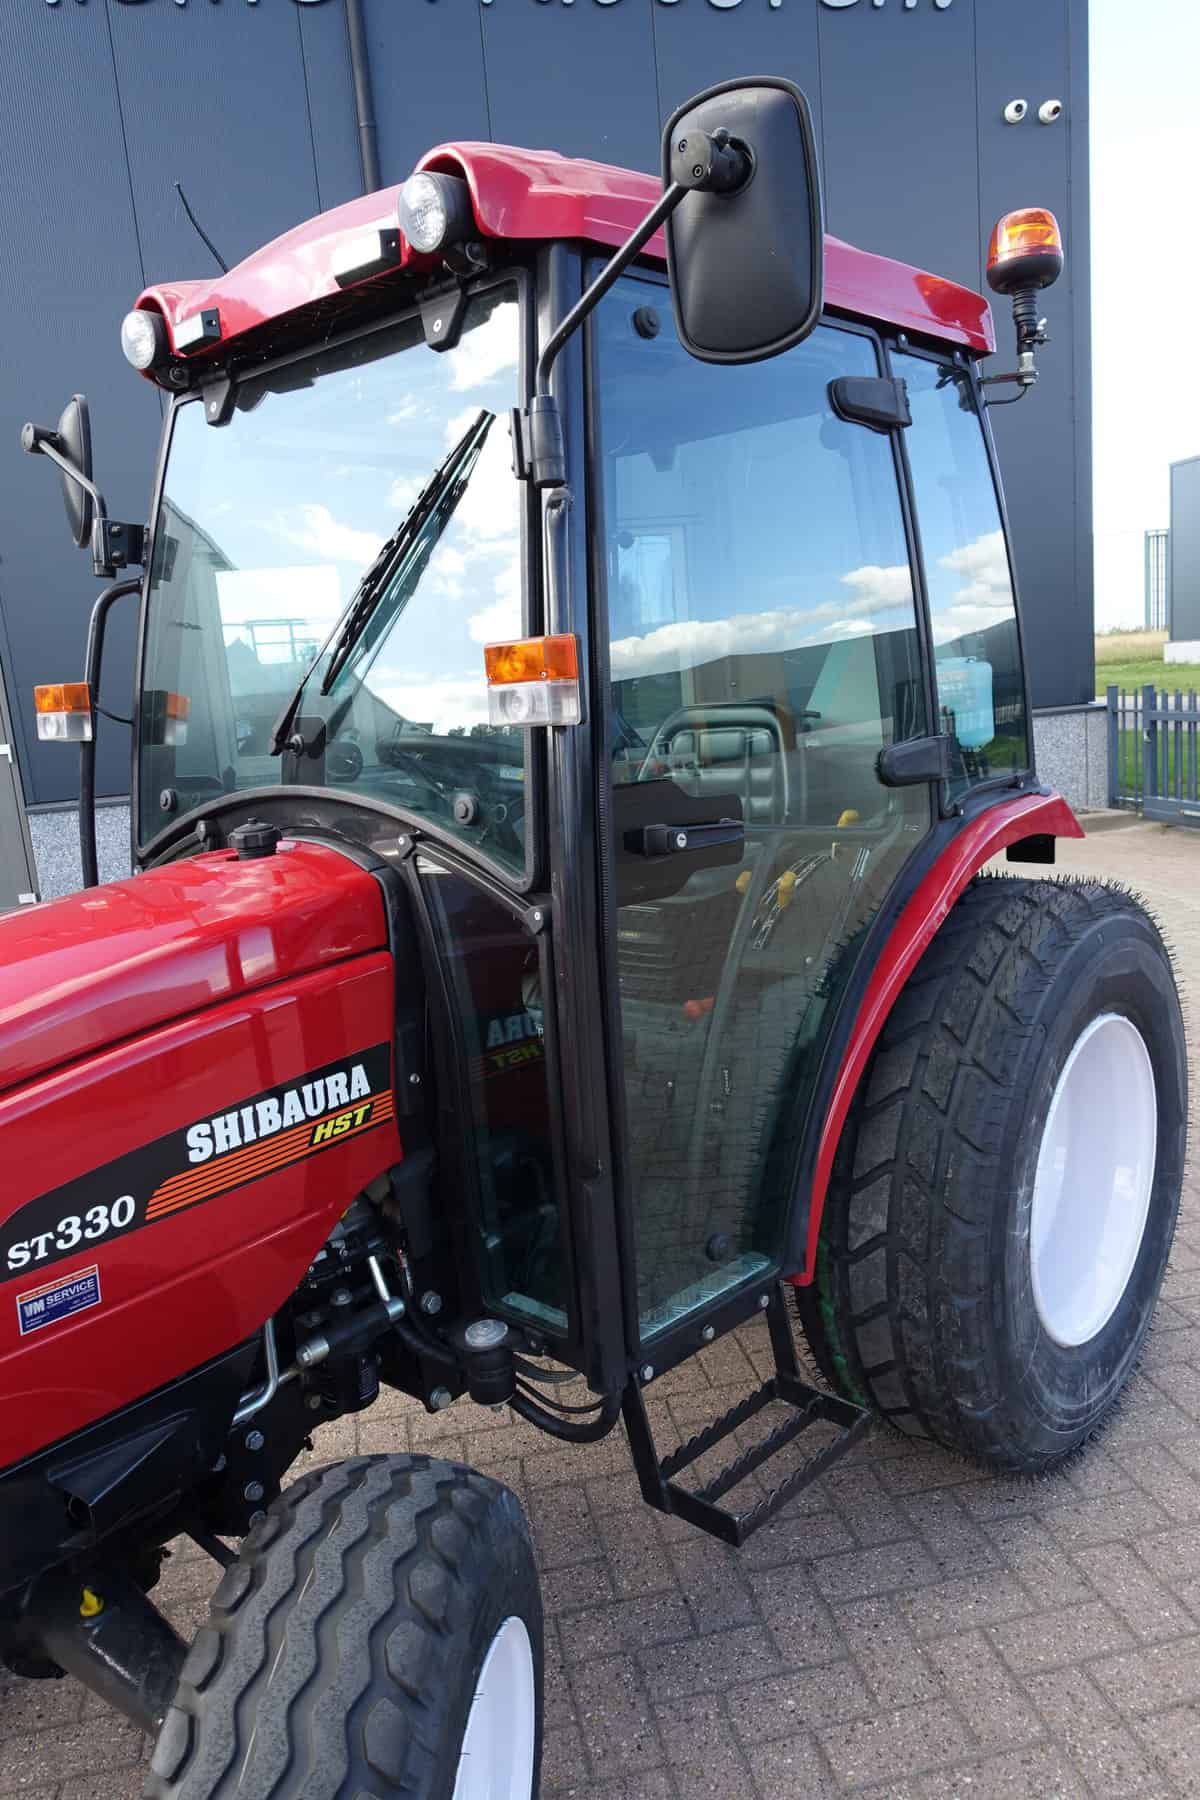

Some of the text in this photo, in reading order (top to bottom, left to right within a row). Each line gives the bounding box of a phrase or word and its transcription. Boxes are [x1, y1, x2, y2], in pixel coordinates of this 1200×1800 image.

[186, 1064, 371, 1163] SHIBAURA
[313, 1104, 371, 1144] HST
[7, 1195, 136, 1270] ST330
[46, 1278, 95, 1305] SERVICE
